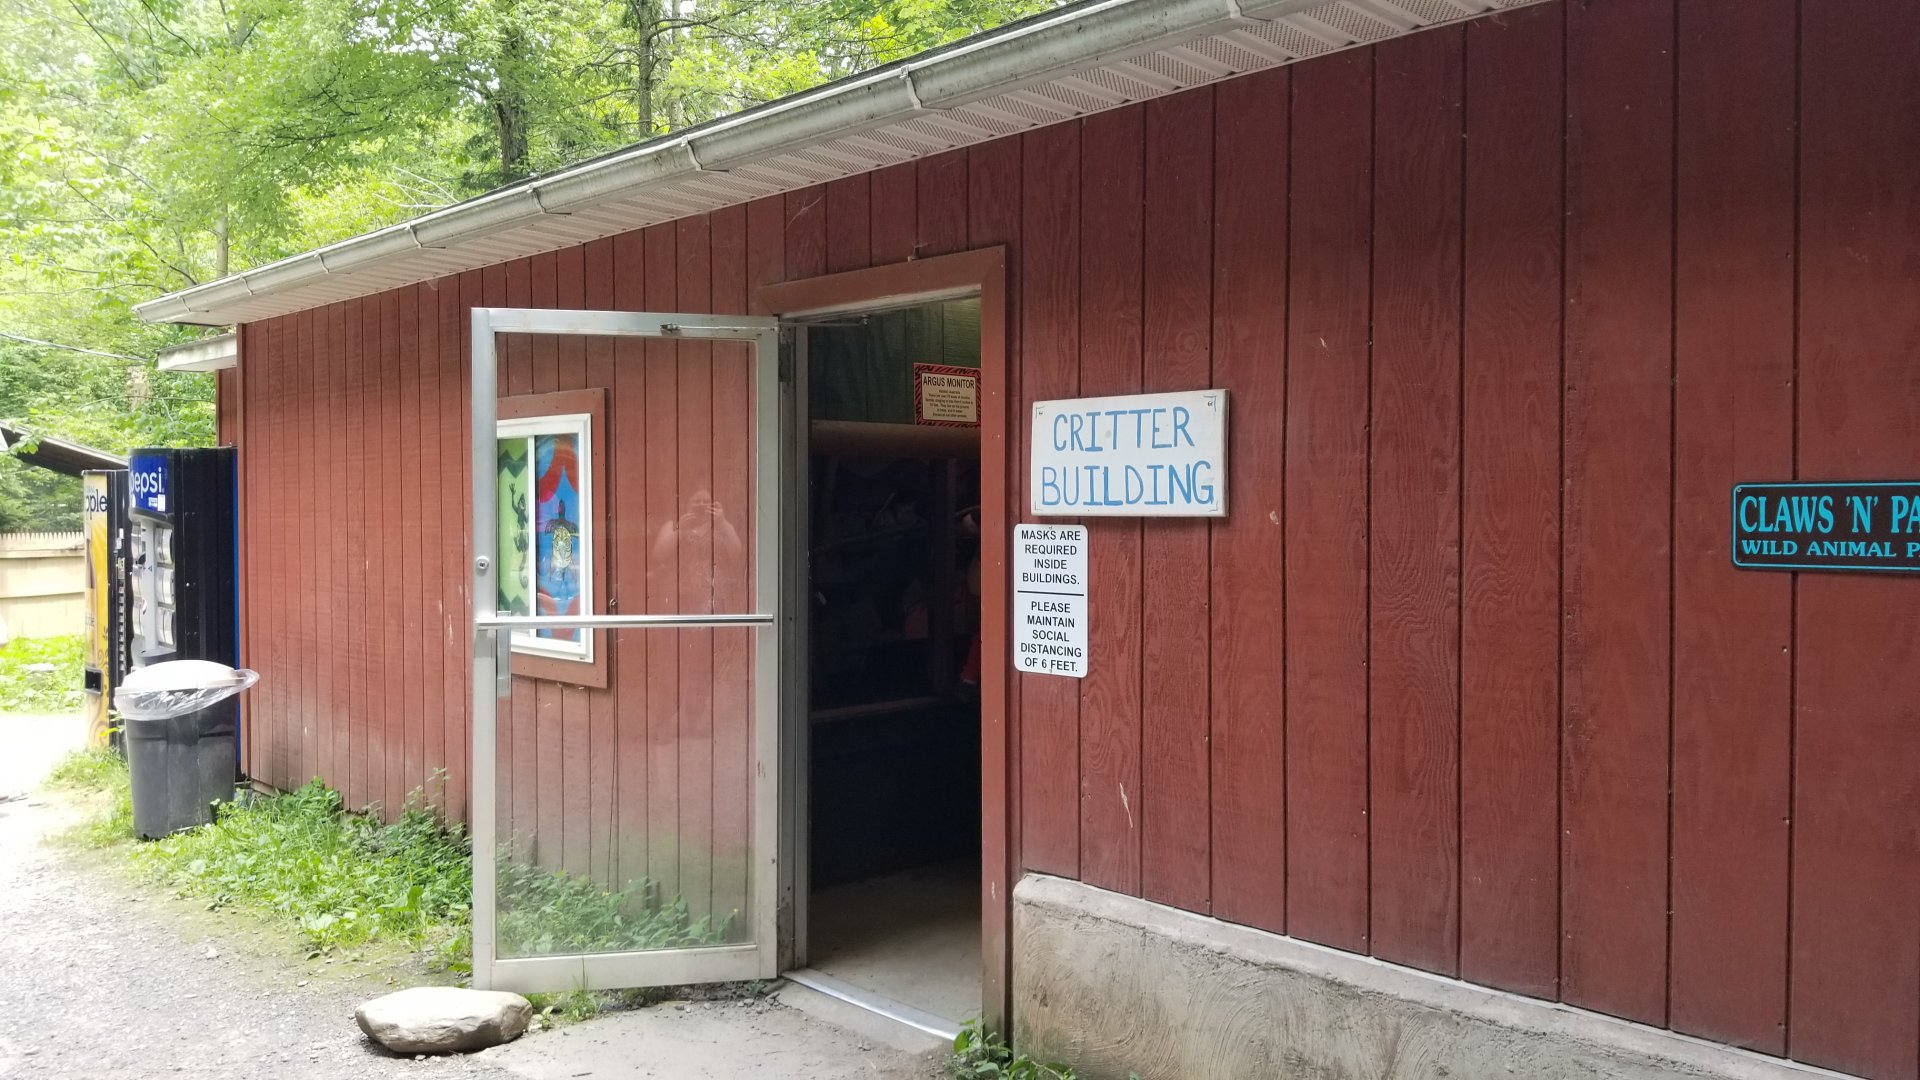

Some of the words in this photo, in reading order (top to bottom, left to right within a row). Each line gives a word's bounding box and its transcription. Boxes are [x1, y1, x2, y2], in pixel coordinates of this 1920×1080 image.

[923, 376, 945, 387] ARGUS
[947, 378, 975, 389] MONITOR
[1053, 406, 1195, 452] CRITTER
[1042, 460, 1214, 506] BUILDING
[1739, 495, 1834, 534] CLAWS
[1846, 496, 1879, 534] 'N'
[1022, 530, 1056, 540] MASKS
[1060, 530, 1081, 541] ARE
[1025, 544, 1077, 556] REQUIRED
[1741, 540, 1798, 555] WILD
[1806, 541, 1897, 557] ANIMAL
[1034, 559, 1067, 569] INSIDE
[1022, 573, 1080, 585] BUILDINGS.
[1031, 601, 1070, 613] PLEASE
[1027, 615, 1075, 628] MAINTAIN
[1032, 630, 1070, 642] SOCIAL
[1021, 643, 1082, 658] DISTANCING
[1024, 657, 1038, 667] OF
[1041, 659, 1047, 669] 6
[1050, 660, 1078, 672] FEET.
